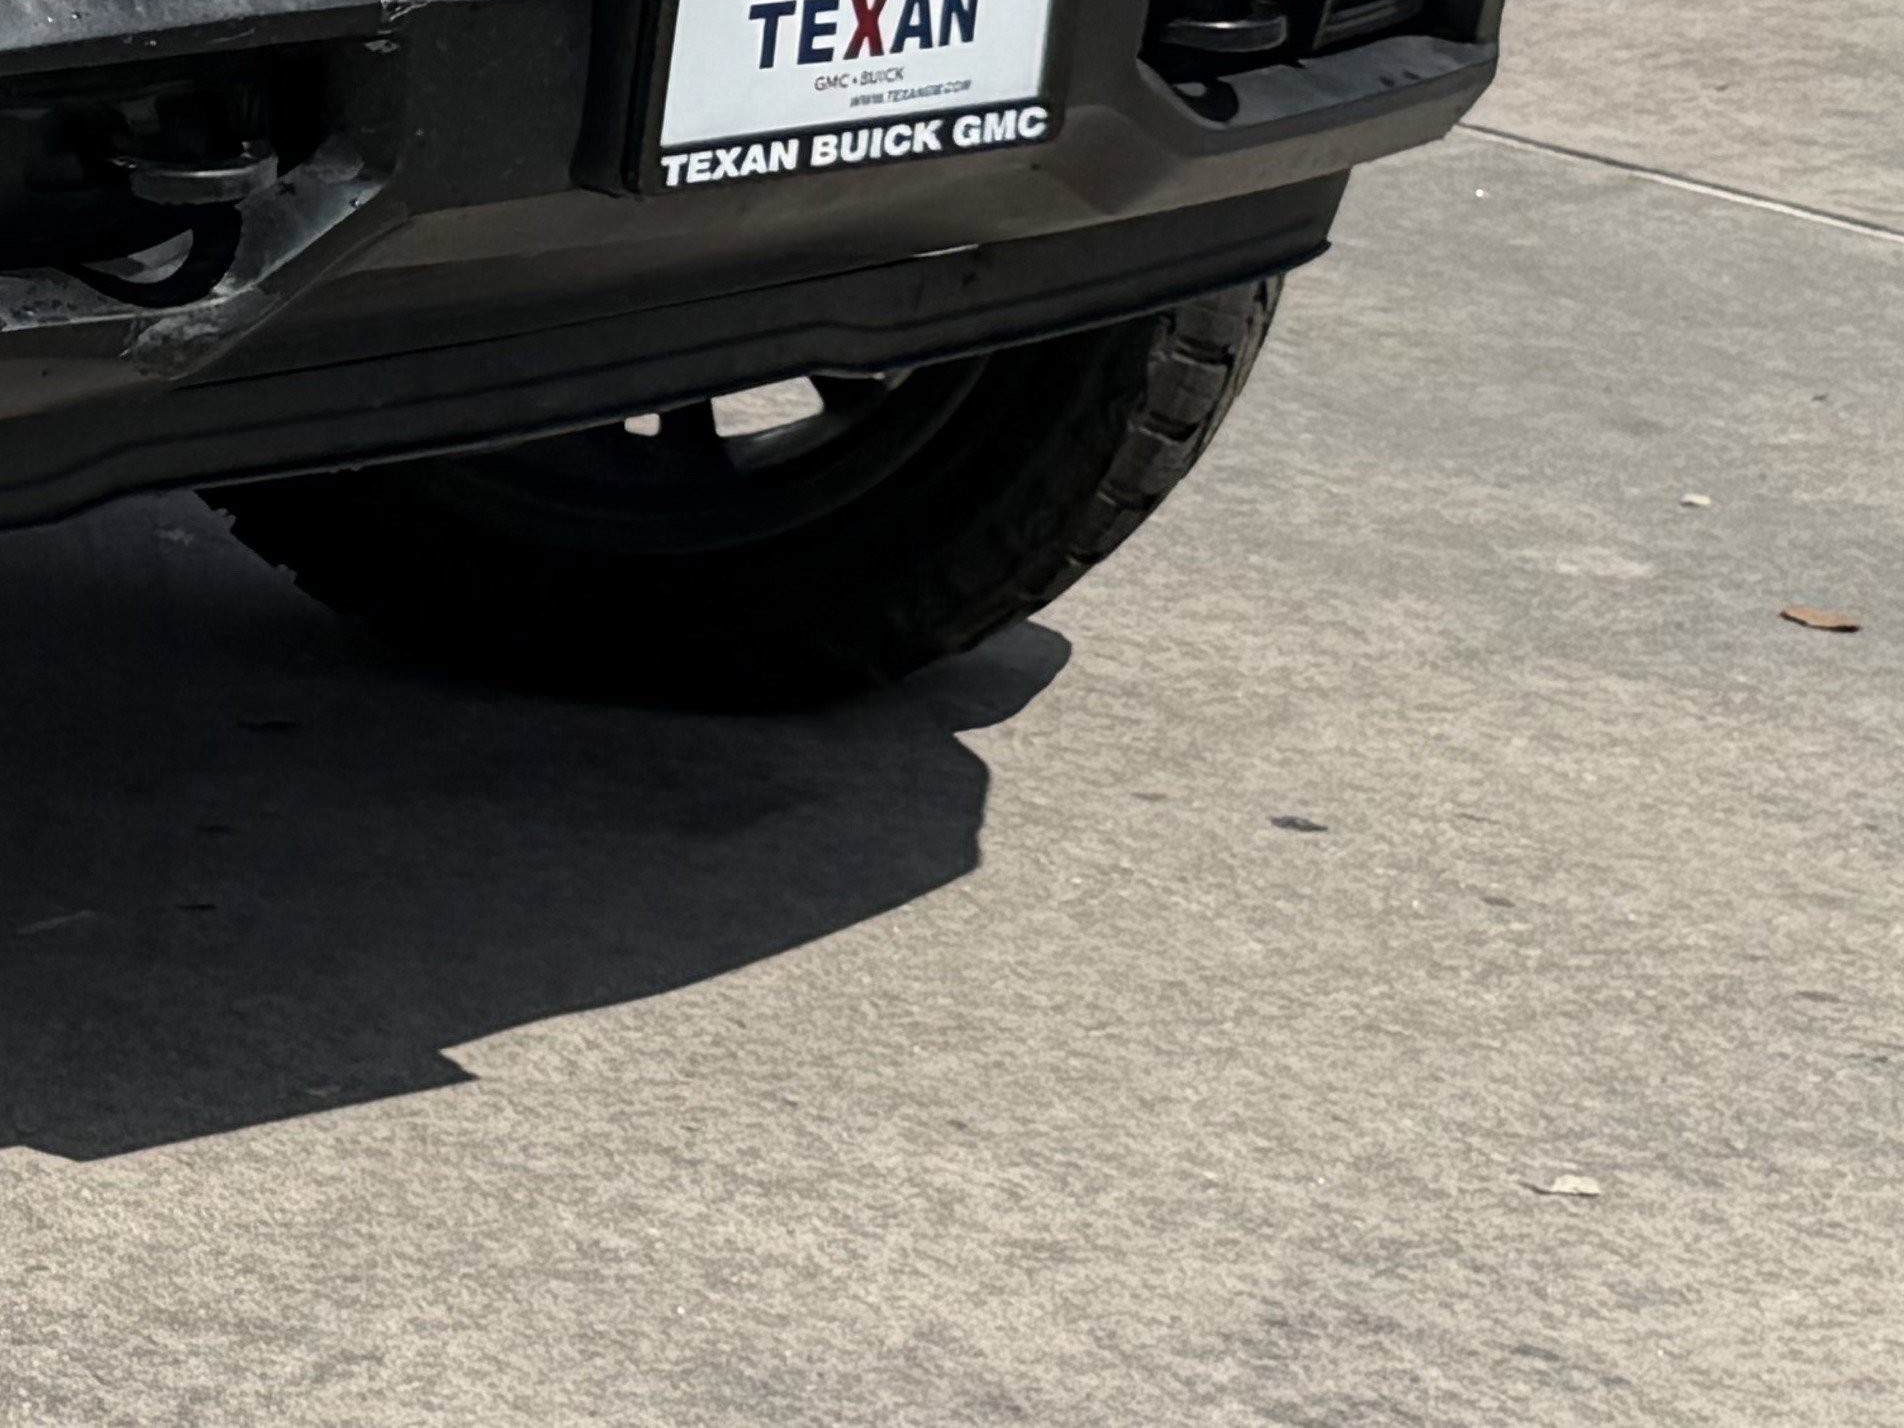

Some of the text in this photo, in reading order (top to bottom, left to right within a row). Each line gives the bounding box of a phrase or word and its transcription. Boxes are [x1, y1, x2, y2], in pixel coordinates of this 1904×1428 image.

[814, 73, 851, 91] GMC
[660, 106, 1049, 187] TEXAN BUICK GMC
